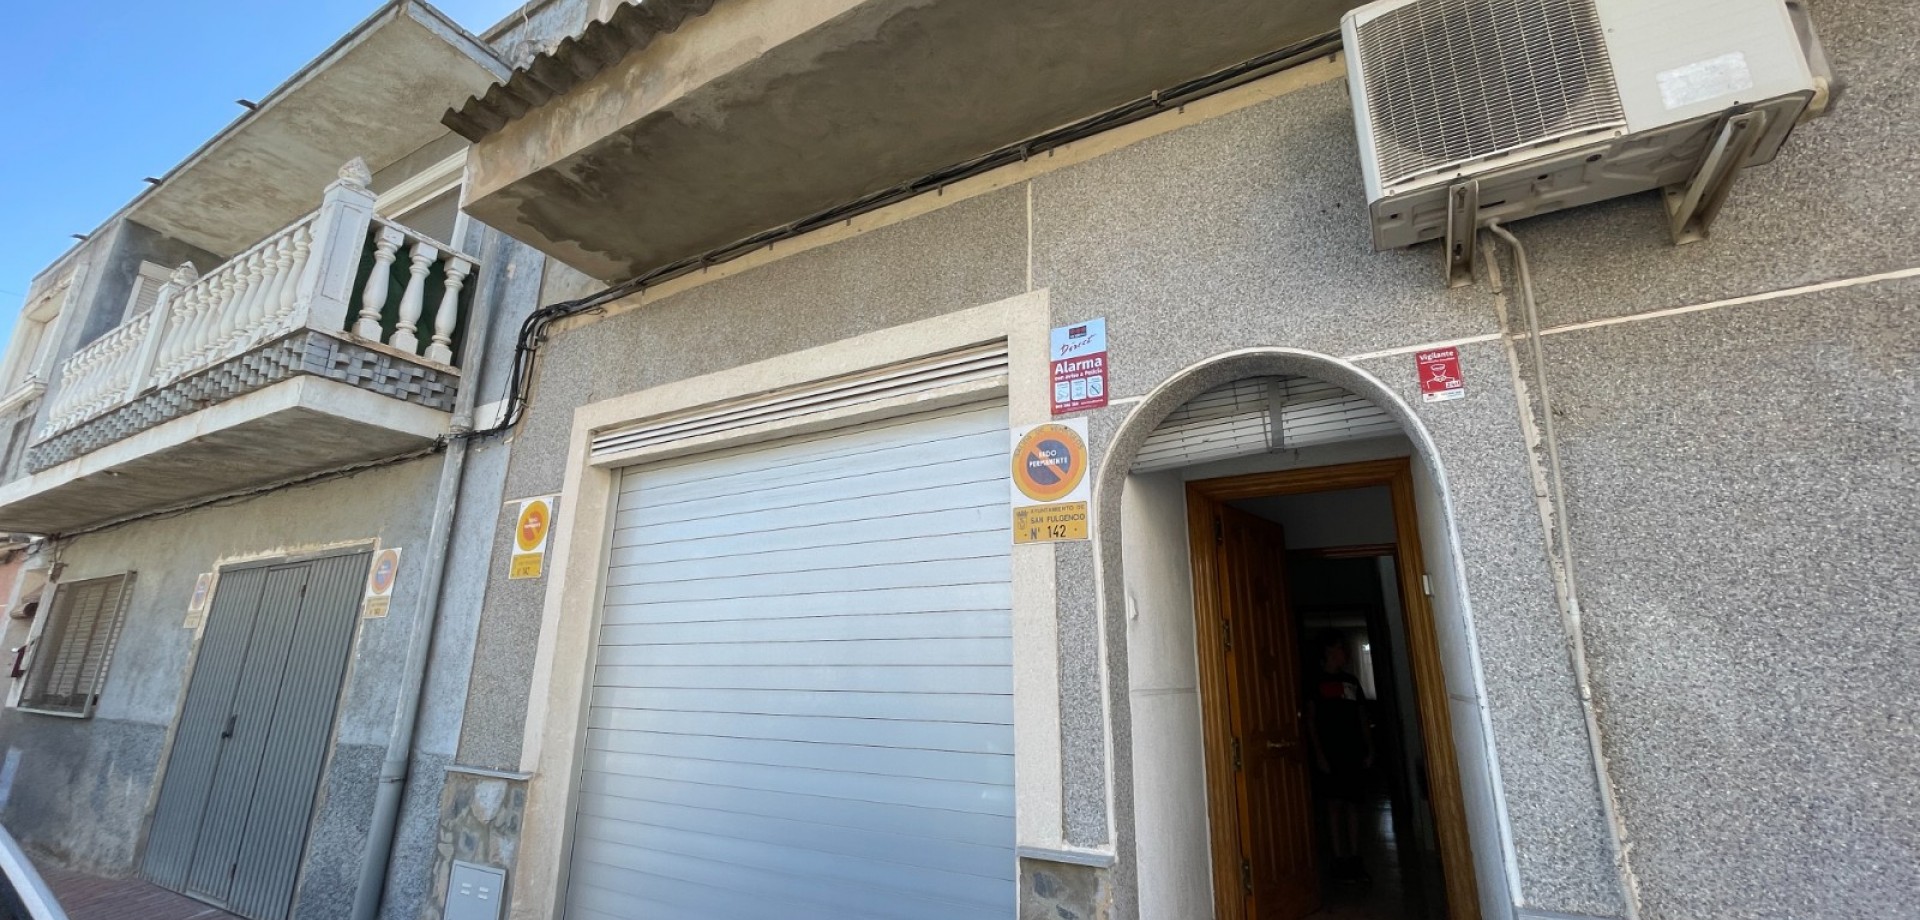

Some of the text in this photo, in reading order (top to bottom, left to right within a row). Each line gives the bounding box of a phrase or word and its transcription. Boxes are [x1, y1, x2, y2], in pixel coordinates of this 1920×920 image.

[1419, 351, 1454, 361] Vigilante
[1055, 357, 1103, 375] Alarma
[1030, 504, 1074, 514] AYUNTAMIENTO
[1030, 513, 1086, 525] SAN FULGENCIO
[1047, 524, 1067, 539] 142
